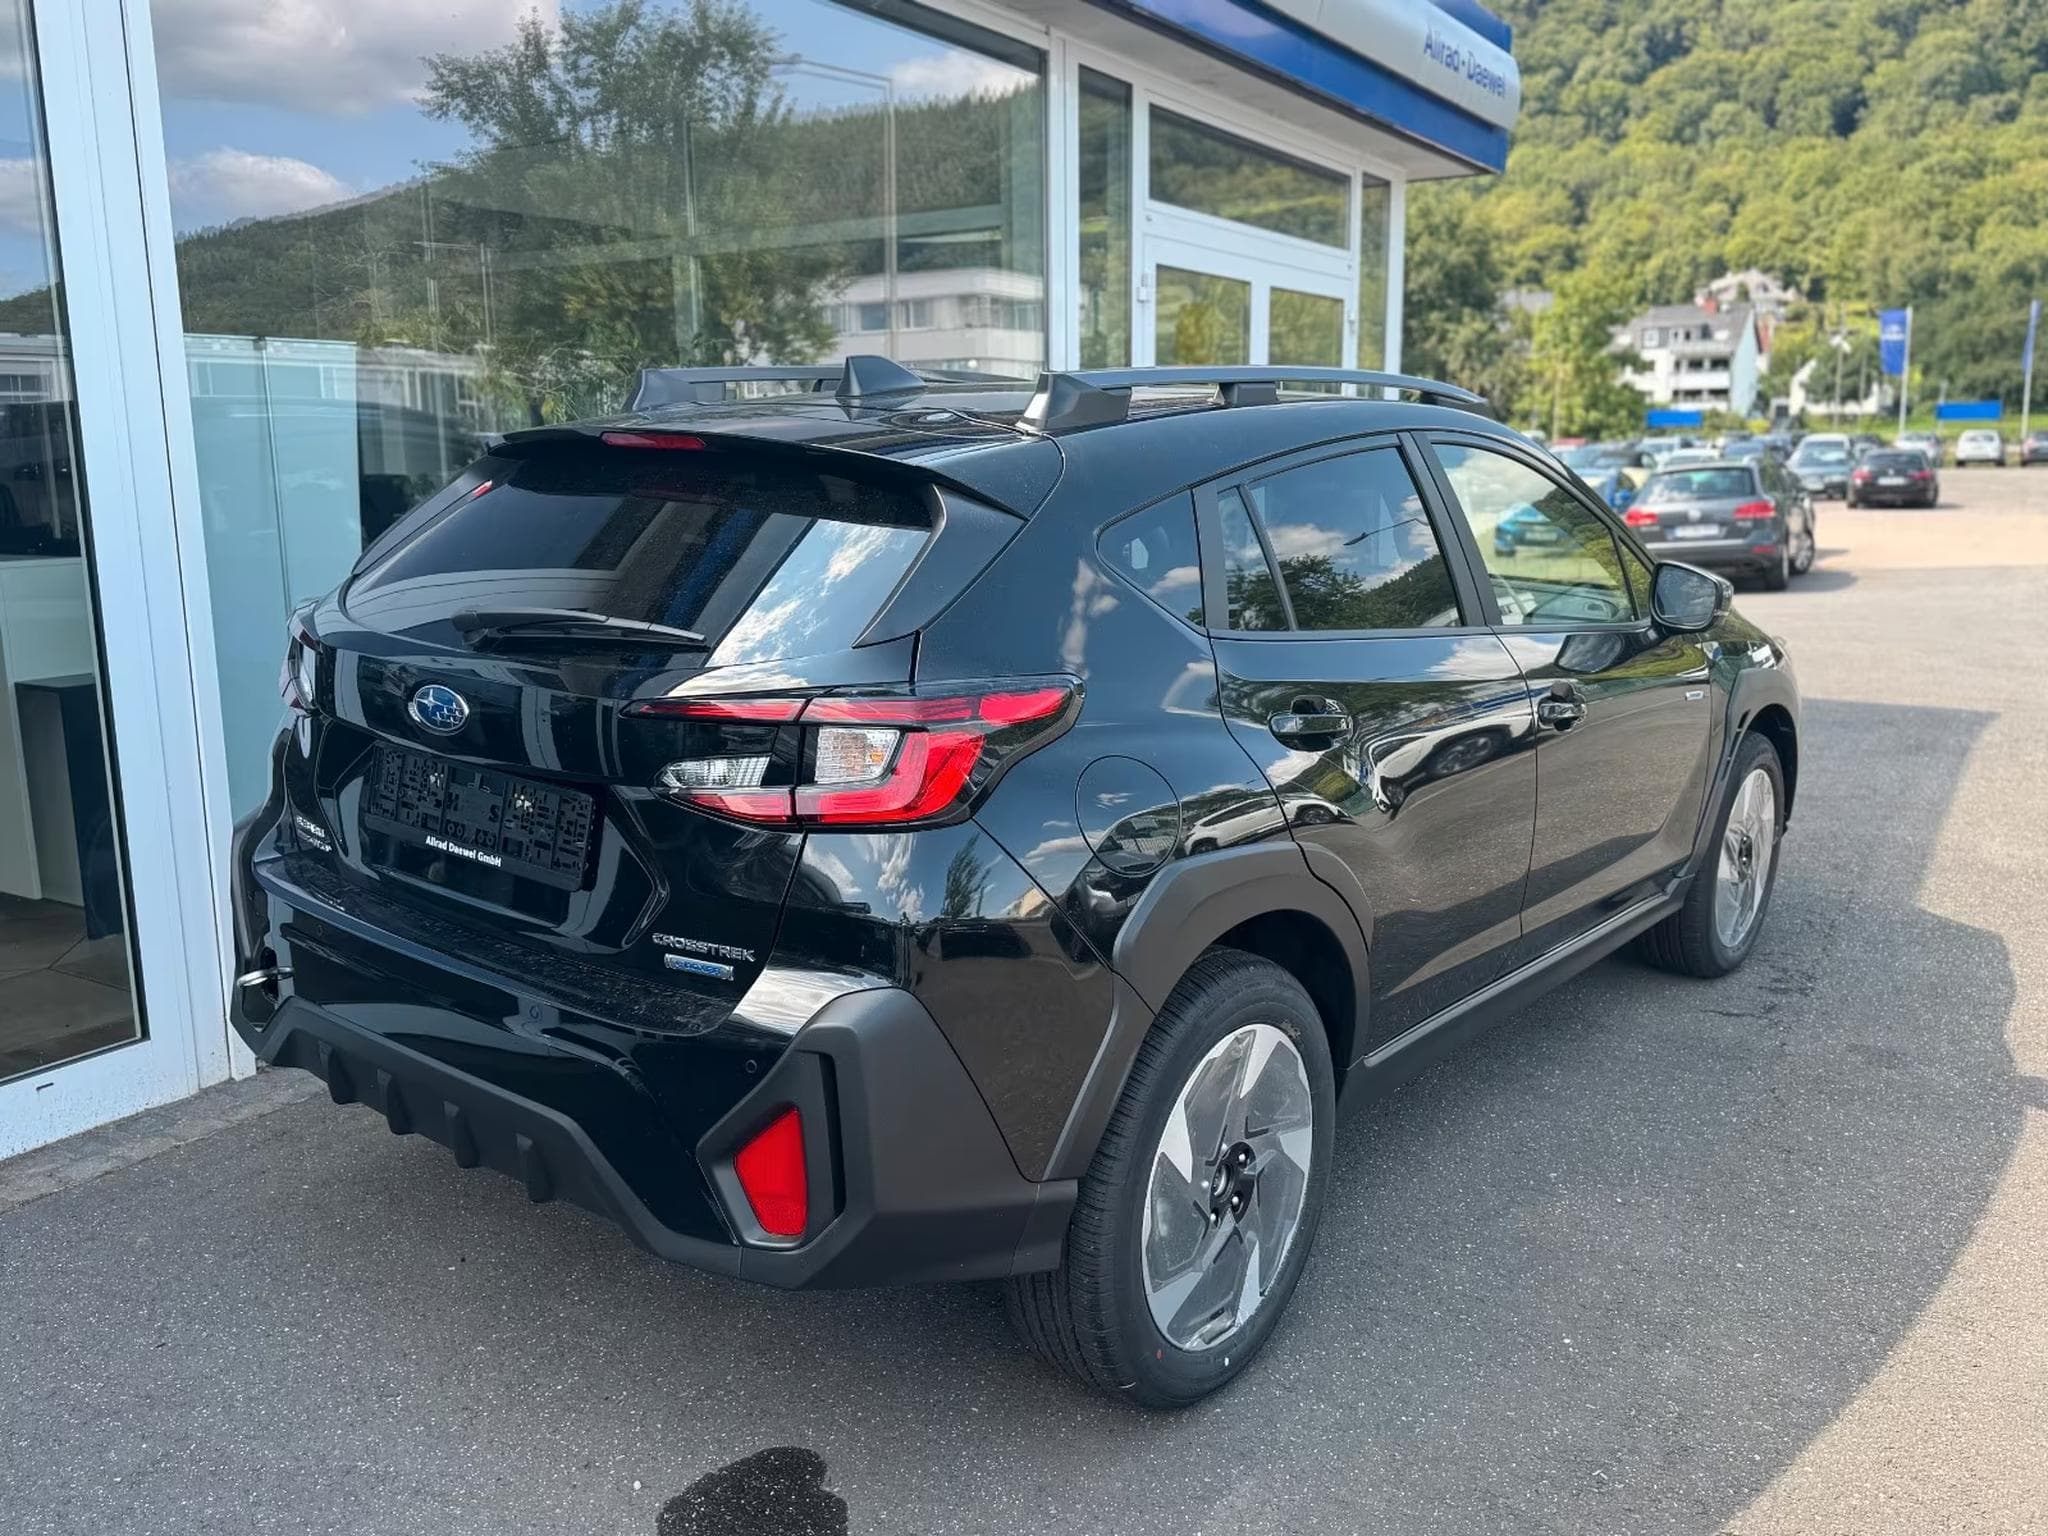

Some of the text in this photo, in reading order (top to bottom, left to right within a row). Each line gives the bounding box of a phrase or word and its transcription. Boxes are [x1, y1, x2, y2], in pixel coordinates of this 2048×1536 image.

[425, 835, 502, 867] Allrad Daewel GmbH
[652, 932, 757, 962] CROSSTREK
